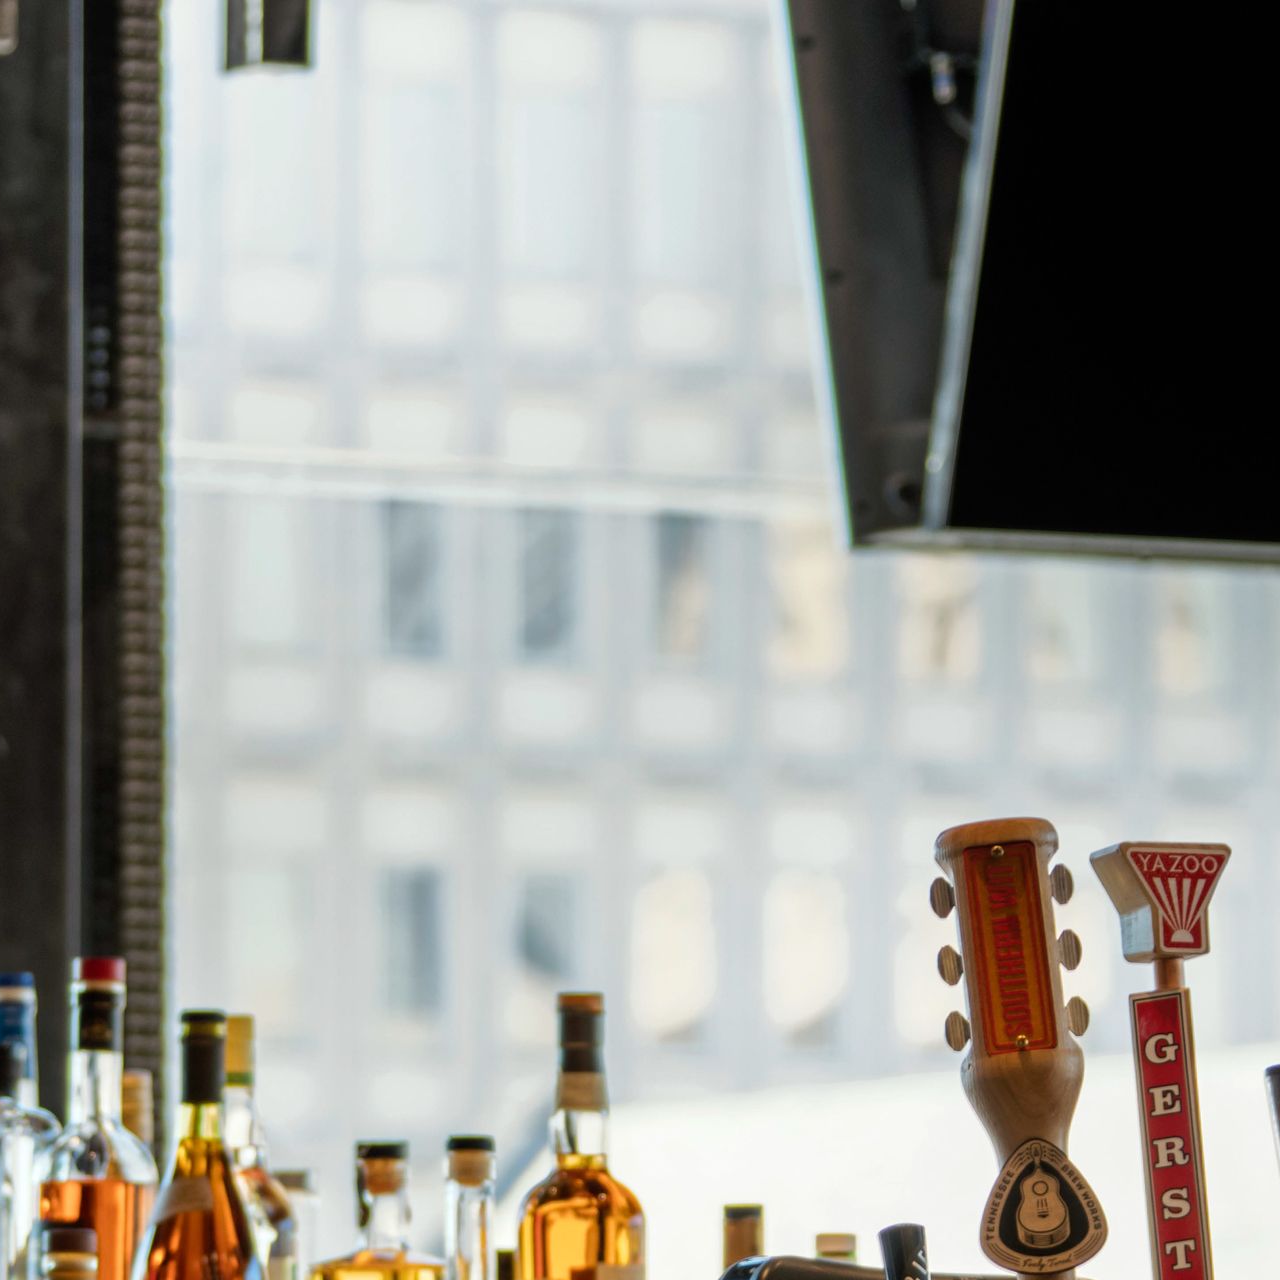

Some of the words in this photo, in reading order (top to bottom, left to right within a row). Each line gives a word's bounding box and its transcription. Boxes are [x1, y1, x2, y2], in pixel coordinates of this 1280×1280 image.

[1138, 854, 1218, 874] YAZOO
[991, 914, 1034, 1038] SOUTHERN
[1144, 1032, 1197, 1272] GERST
[985, 1169, 1015, 1242] TENNESSEE
[1060, 1163, 1085, 1191] BREW
[1082, 1192, 1103, 1231] WORKS
